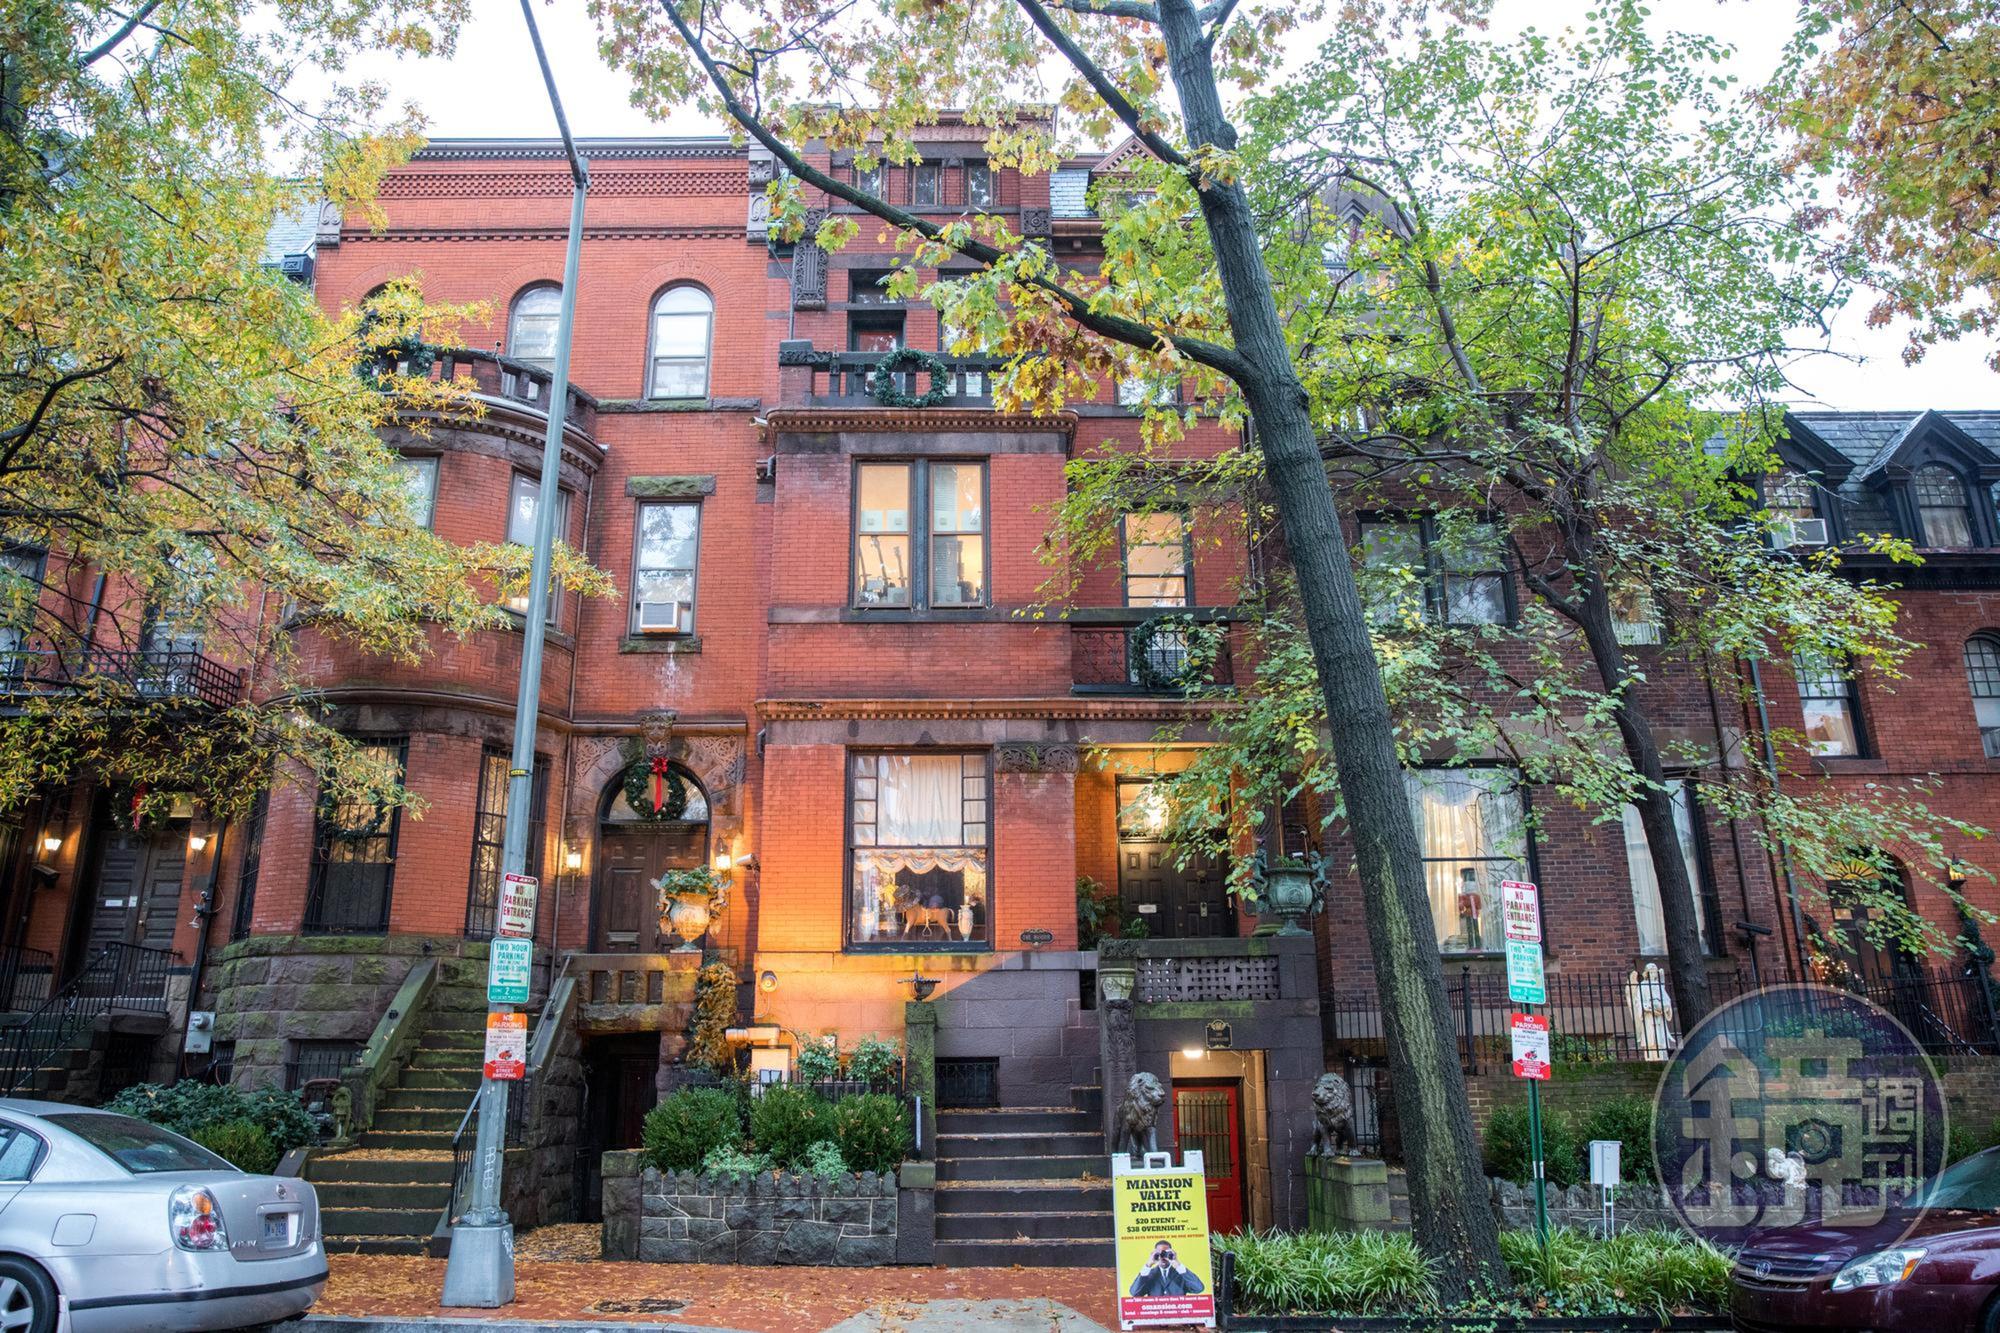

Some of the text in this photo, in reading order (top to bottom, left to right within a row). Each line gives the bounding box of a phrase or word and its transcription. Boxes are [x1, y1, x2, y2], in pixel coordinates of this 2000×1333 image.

[515, 885, 524, 895] NO
[1515, 891, 1524, 900] NO
[504, 895, 533, 908] PARKING
[1506, 900, 1535, 912] PARKING
[503, 906, 532, 919] ENTRANCE
[1507, 911, 1536, 923] ENTRANCE
[511, 944, 529, 952] HOUR
[497, 952, 525, 960] PARKING
[1512, 953, 1537, 963] PARKING
[504, 986, 510, 996] 2
[1523, 987, 1529, 996] 2
[1523, 1015, 1535, 1023] NO
[492, 1021, 523, 1029] PARKING
[1515, 1021, 1544, 1031] PARKING
[1126, 1178, 1193, 1190] MANSION
[1139, 1190, 1181, 1201] VALET
[1131, 1200, 1192, 1212] PARKING
[1141, 1224, 1186, 1232] OVERNIGHT
[1141, 1303, 1193, 1311] omansion.com
